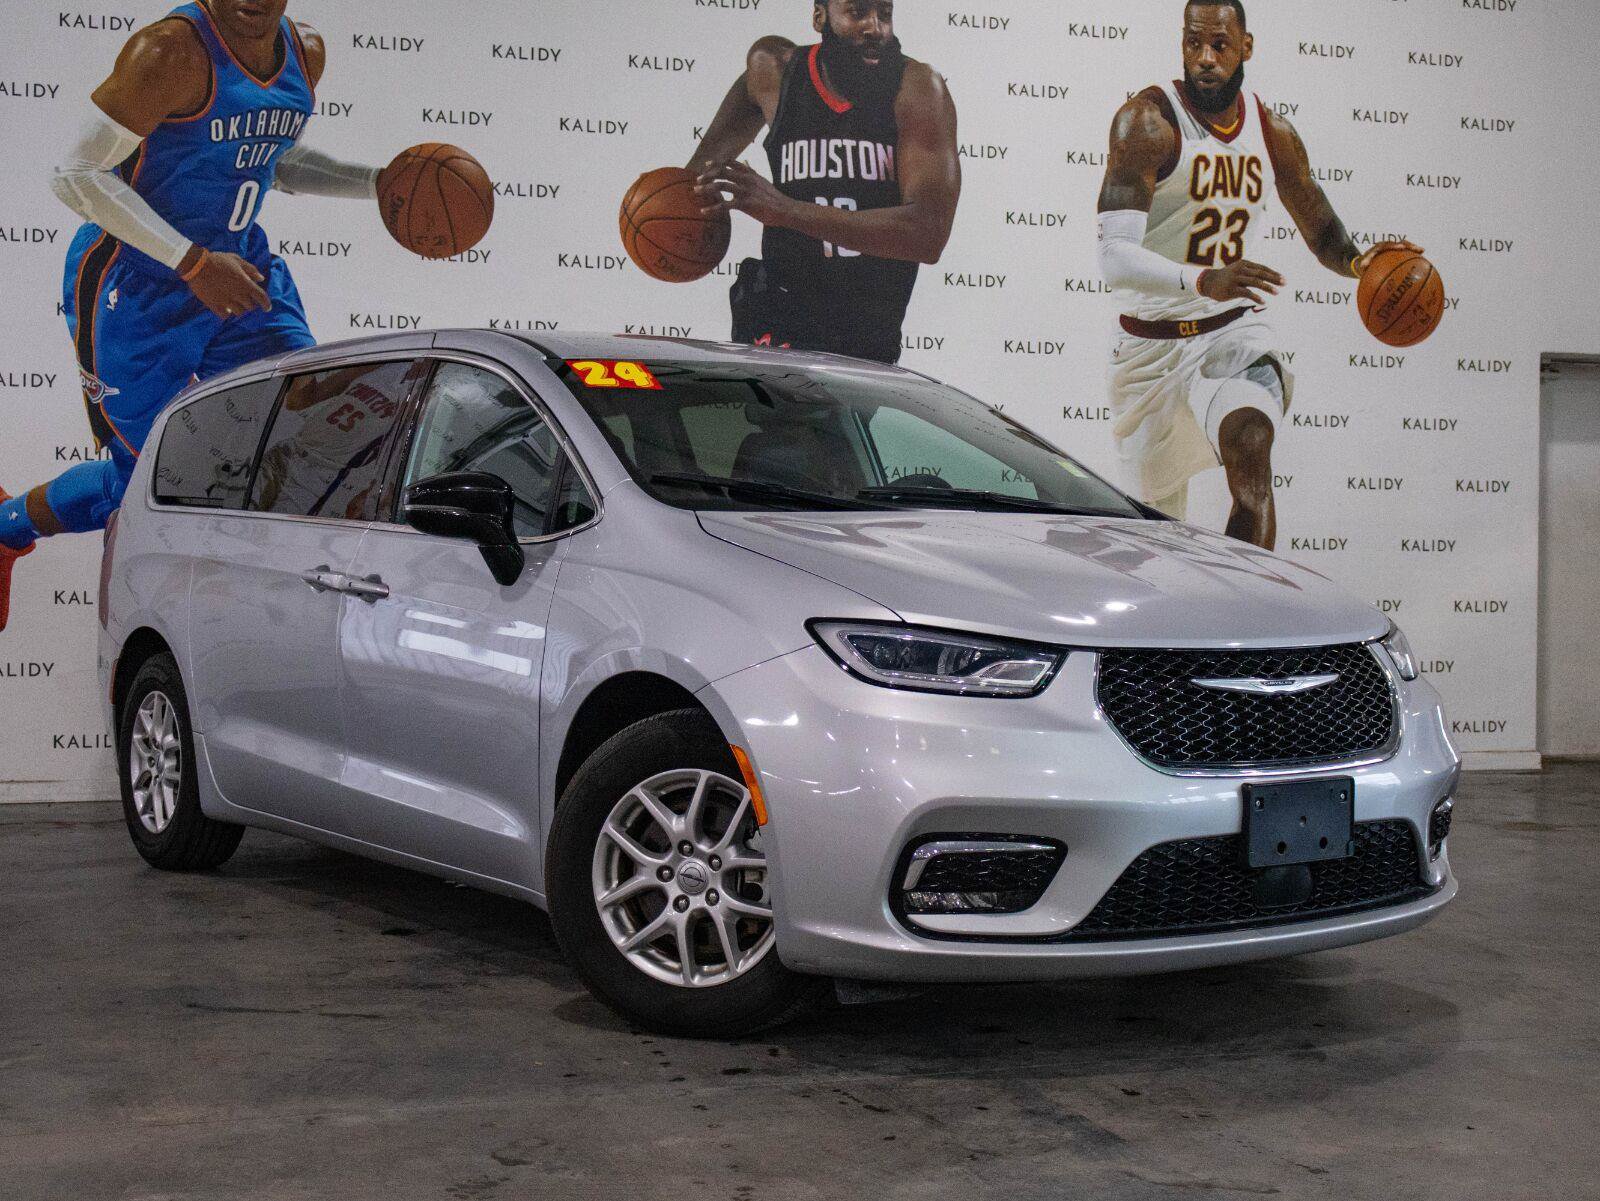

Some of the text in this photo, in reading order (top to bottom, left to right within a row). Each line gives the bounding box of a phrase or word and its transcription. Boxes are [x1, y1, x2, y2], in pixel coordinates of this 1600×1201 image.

[59, 12, 136, 32] KALIDY
[948, 13, 1010, 31] KALIDY
[1069, 23, 1129, 40] KALIDY
[353, 34, 425, 53] KALIDY
[1299, 42, 1355, 59] KALIDY
[492, 44, 562, 62] KALIDY
[1408, 51, 1464, 68] KALIDY
[628, 54, 696, 73] KALIDY
[0, 81, 60, 99] ALIDY
[1008, 82, 1069, 100] KALIDY
[312, 102, 354, 118] IDY
[422, 108, 494, 127] KALIDY
[1353, 108, 1409, 125] KALIDY
[210, 109, 304, 142] OKLAHOM
[559, 118, 629, 136] KALIDY
[1461, 117, 1515, 133] KALIDY
[235, 142, 279, 169] CITY
[958, 144, 1008, 160] ALIDY
[1067, 151, 1104, 167] KALI
[781, 138, 894, 184] HOUSTON
[1189, 153, 1263, 204] CAVS
[1308, 168, 1354, 182] ALIDY
[1407, 174, 1462, 190] KALIDY
[491, 181, 561, 199] KALIDY
[228, 180, 260, 232] 0
[1006, 211, 1068, 228] KALIDY
[0, 226, 59, 244] ALIDY
[1186, 206, 1251, 267] 23
[1264, 226, 1298, 241] IDY
[279, 240, 353, 257] KALIDY
[1459, 237, 1514, 253] KALIDY
[558, 253, 627, 271] KALIDY
[944, 272, 1007, 289] KALIDY
[1295, 290, 1352, 306] KALIDY
[350, 313, 422, 330] KALIDY
[1179, 321, 1200, 337] CLE
[900, 335, 945, 351] LIDY
[1004, 340, 1066, 356] KALIDY
[1349, 353, 1406, 369] KALIDY
[1457, 359, 1512, 373] KALIDY
[1063, 405, 1110, 421] KALID
[1292, 413, 1350, 430] KALIDY
[1403, 417, 1458, 432] KALIDY
[1347, 476, 1404, 491] KALIDY
[1456, 479, 1511, 494] KALIDY
[1291, 535, 1348, 551] KALIDY
[1401, 539, 1456, 554] KALIDY
[54, 590, 94, 605] KAL
[1454, 600, 1508, 613] KALIDY
[0, 662, 55, 678] LIDY
[1420, 660, 1455, 674] LIDY
[1452, 720, 1507, 733] KALIDY
